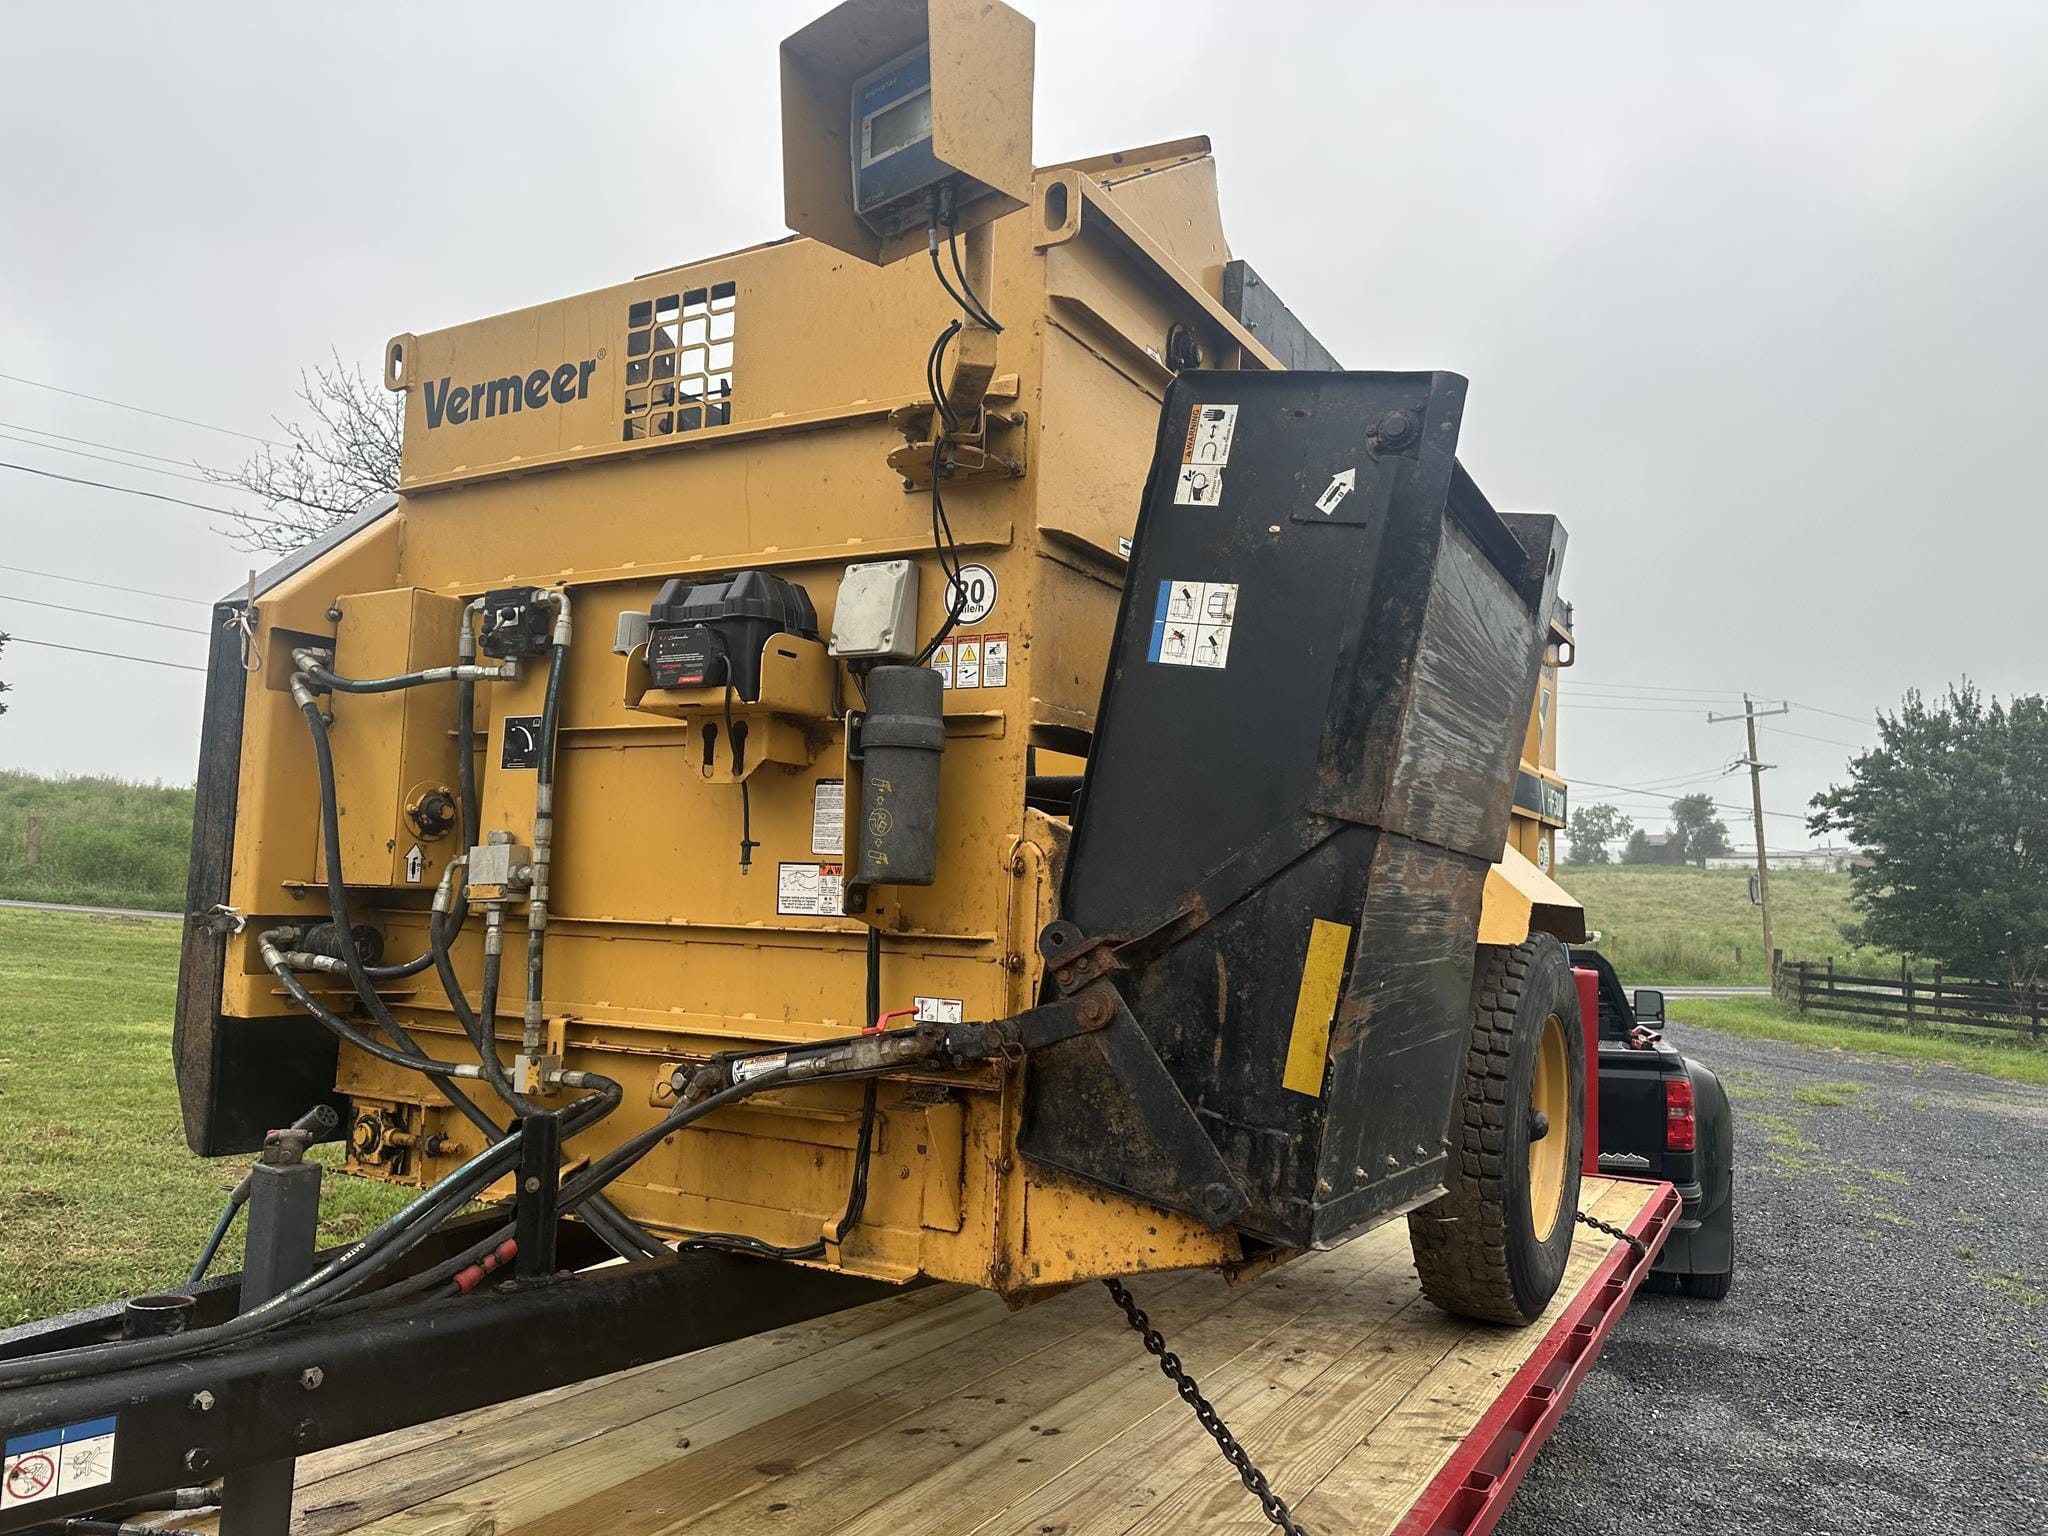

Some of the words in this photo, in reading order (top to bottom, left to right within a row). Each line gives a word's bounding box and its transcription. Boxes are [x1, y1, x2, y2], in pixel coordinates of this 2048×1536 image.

[423, 358, 596, 429] Vermeer
[1185, 409, 1200, 450] WARNING
[340, 1242, 366, 1262] GATES
